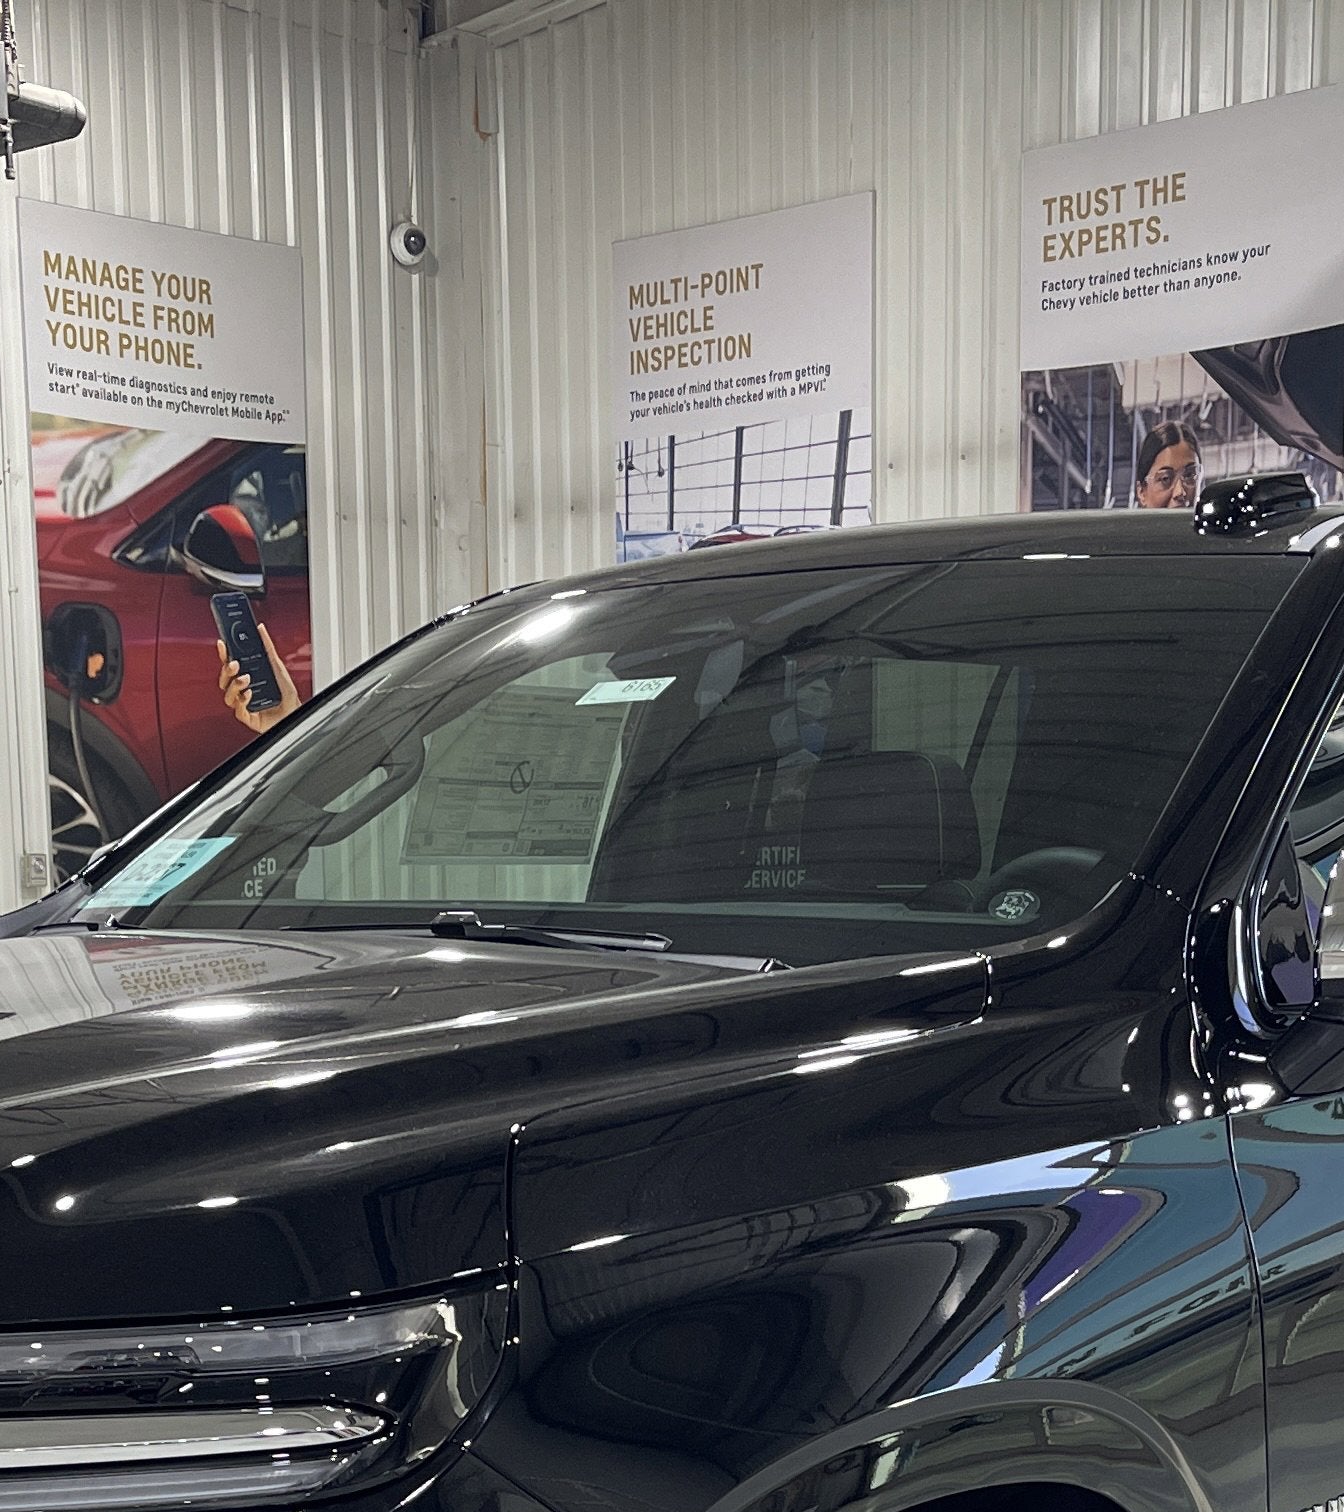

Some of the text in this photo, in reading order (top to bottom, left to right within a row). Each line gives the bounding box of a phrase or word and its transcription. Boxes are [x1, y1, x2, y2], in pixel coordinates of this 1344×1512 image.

[1042, 172, 1185, 225] TRUST THE
[1043, 215, 1168, 262] EXPERTS.
[44, 250, 212, 305] MANAGE YOUR
[629, 263, 763, 310] MULTI-POINT
[1042, 244, 1270, 293] Factory trained technicians know your
[1042, 271, 1241, 311] Chevy vehicle better than anyone.
[44, 285, 214, 339] VEHICLE FROM
[629, 305, 713, 342] VEHICLE
[46, 319, 202, 369] YOUR PHONE.
[630, 332, 751, 375] INSPECTION
[48, 362, 274, 407] View real-time diagnostics and enjoy remote
[82, 388, 127, 403] available
[131, 396, 143, 406] on
[146, 395, 162, 408] the
[166, 400, 229, 417] myChevrolet
[231, 401, 262, 420] Mobile
[629, 363, 830, 403] The peace of mind that comes from getting
[630, 407, 650, 422] your
[652, 399, 690, 415] vehicle's
[693, 395, 722, 410] health
[725, 388, 763, 405] checked
[766, 385, 787, 399] with
[790, 387, 795, 396] a
